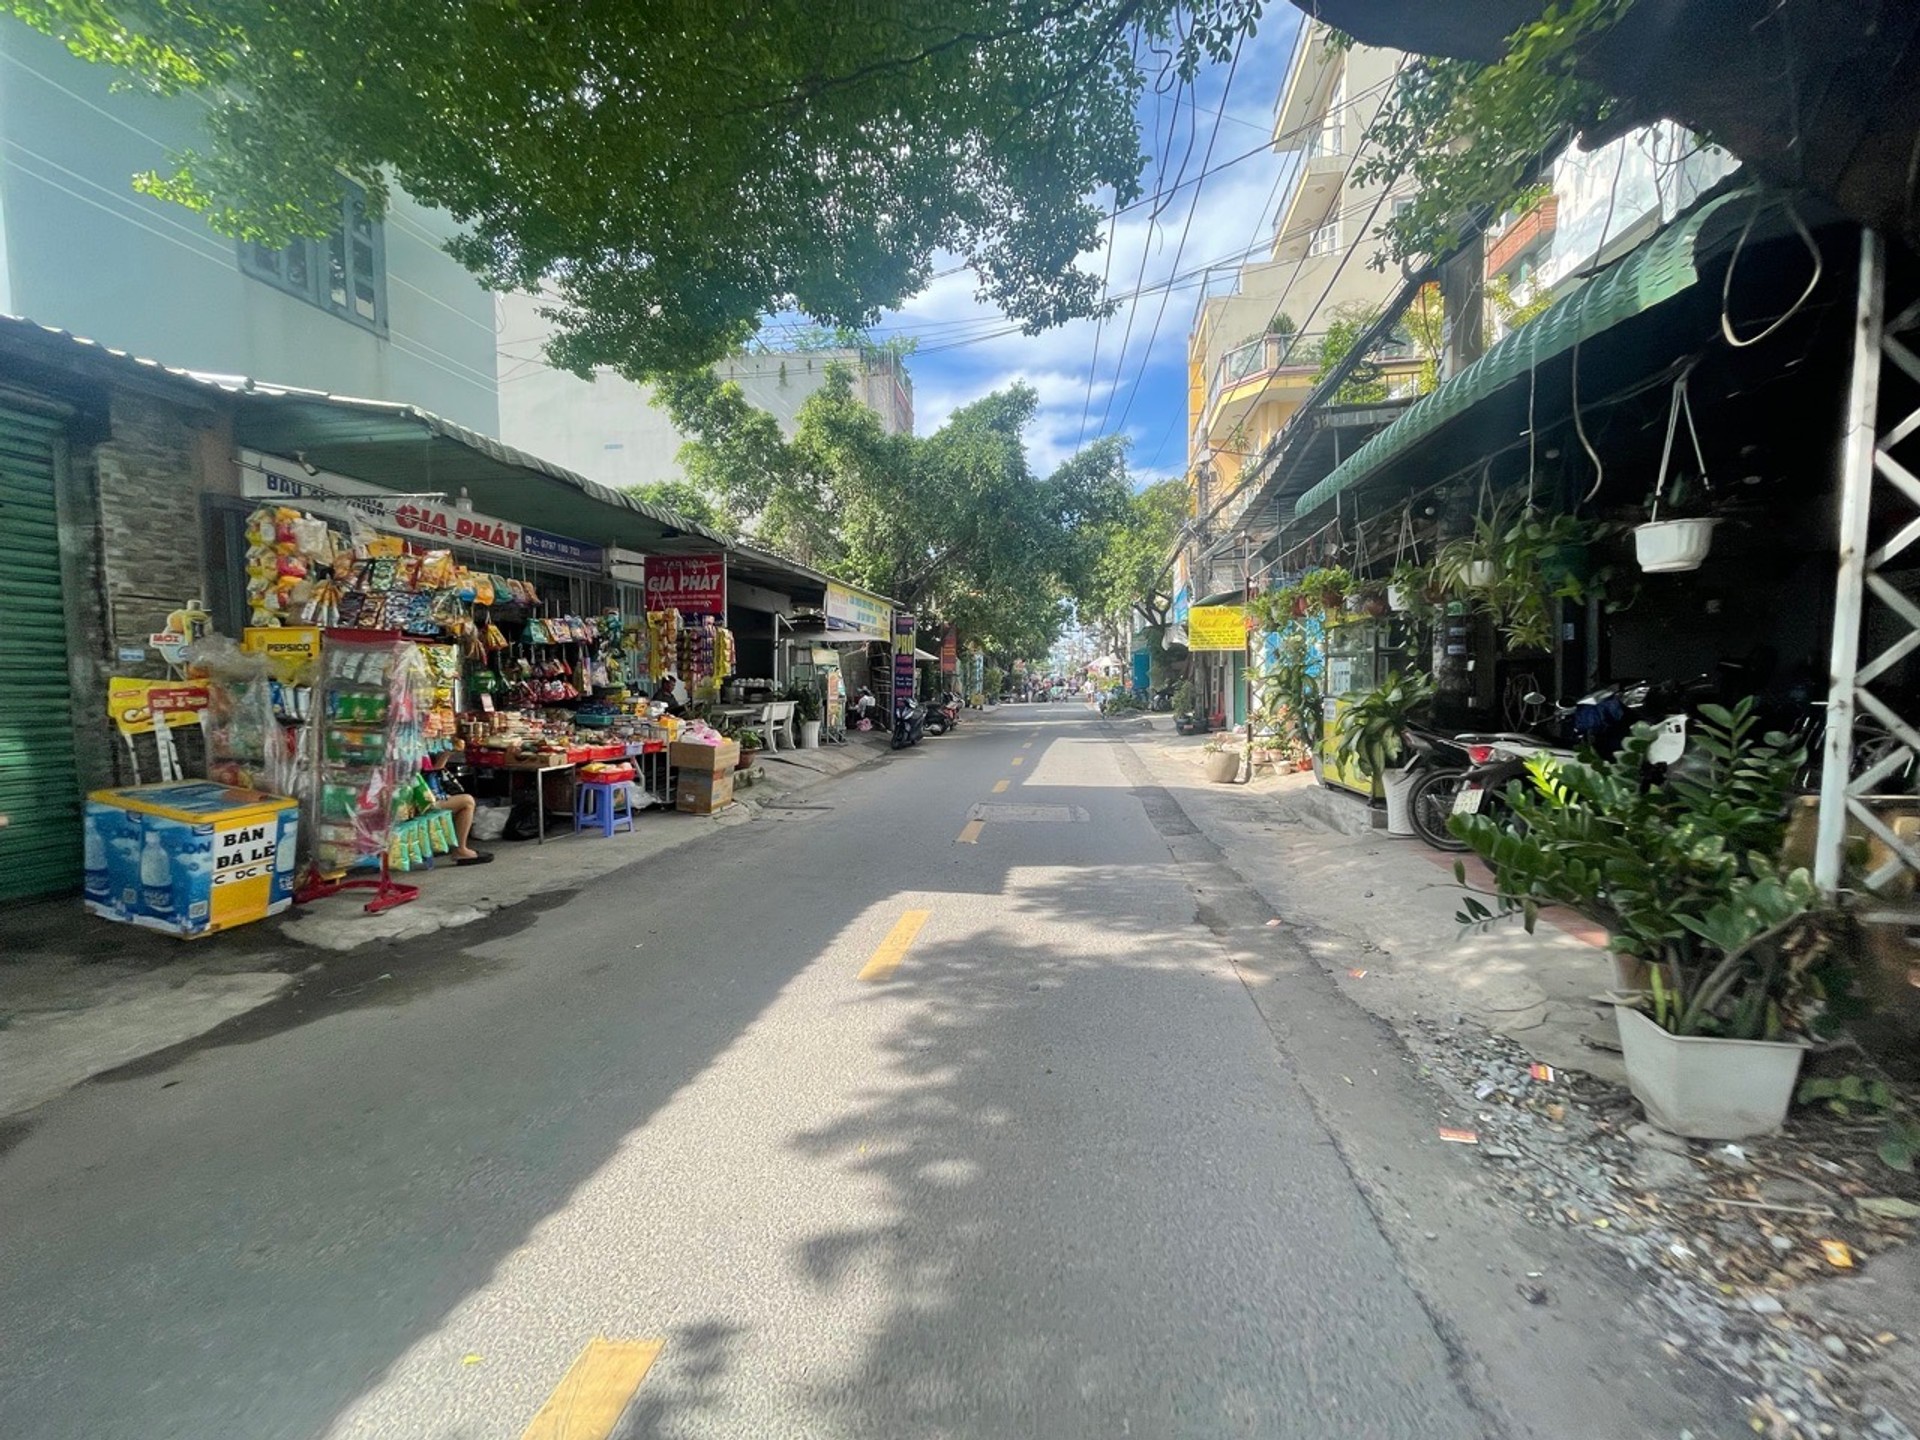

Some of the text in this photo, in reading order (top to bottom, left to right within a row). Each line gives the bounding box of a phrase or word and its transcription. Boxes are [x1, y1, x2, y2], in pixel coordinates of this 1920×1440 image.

[395, 504, 448, 537] GIA
[455, 521, 519, 550] PHÁT
[647, 575, 675, 593] GIA
[267, 643, 310, 652] PEPSICO
[223, 826, 265, 848] BÁN
